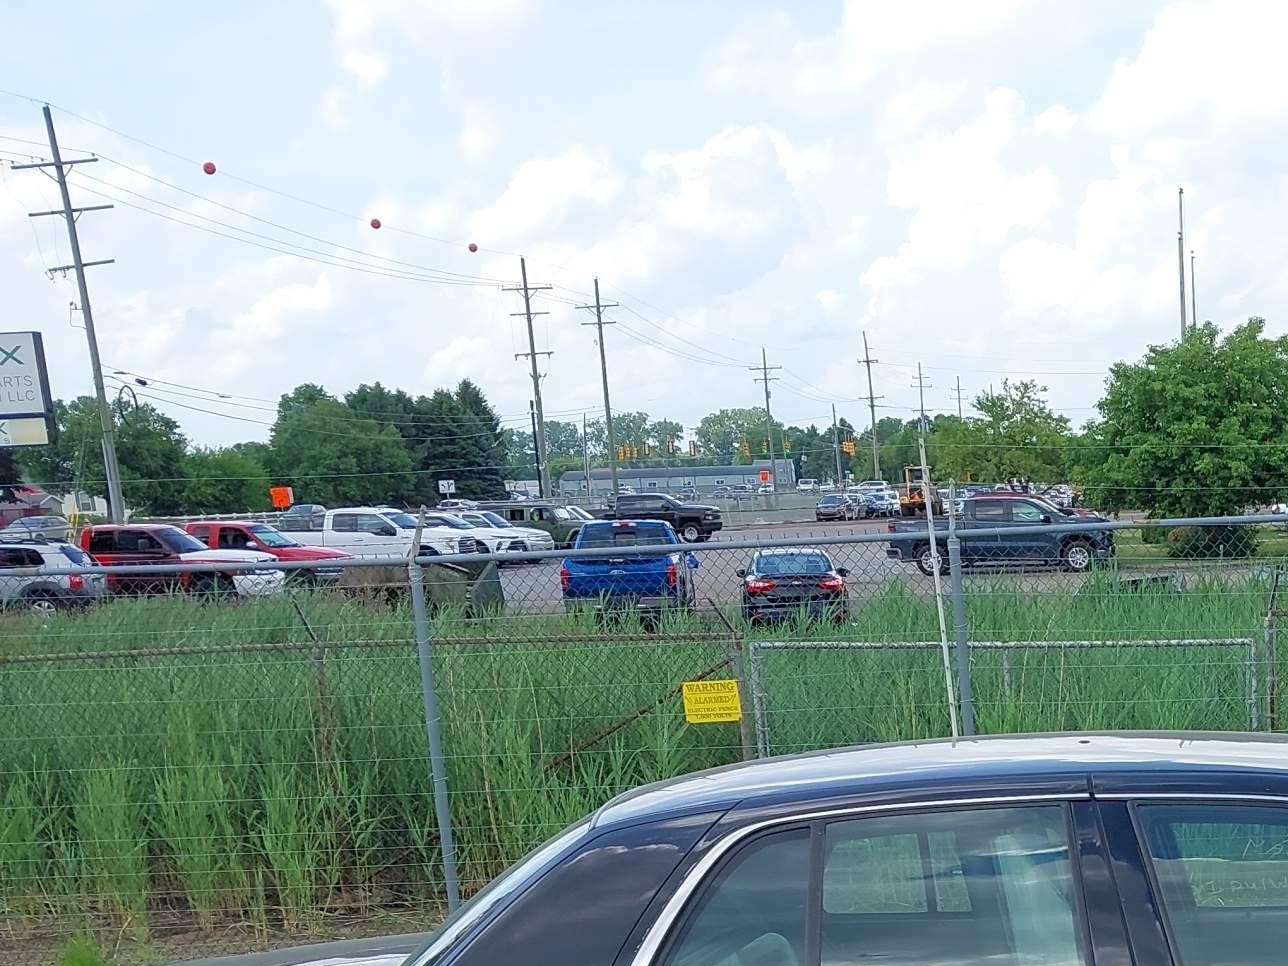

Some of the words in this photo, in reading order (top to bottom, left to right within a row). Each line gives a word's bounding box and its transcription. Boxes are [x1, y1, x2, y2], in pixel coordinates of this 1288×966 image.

[0, 375, 33, 388] RTS
[686, 682, 735, 693] WARNING
[693, 695, 730, 705] ALARMED
